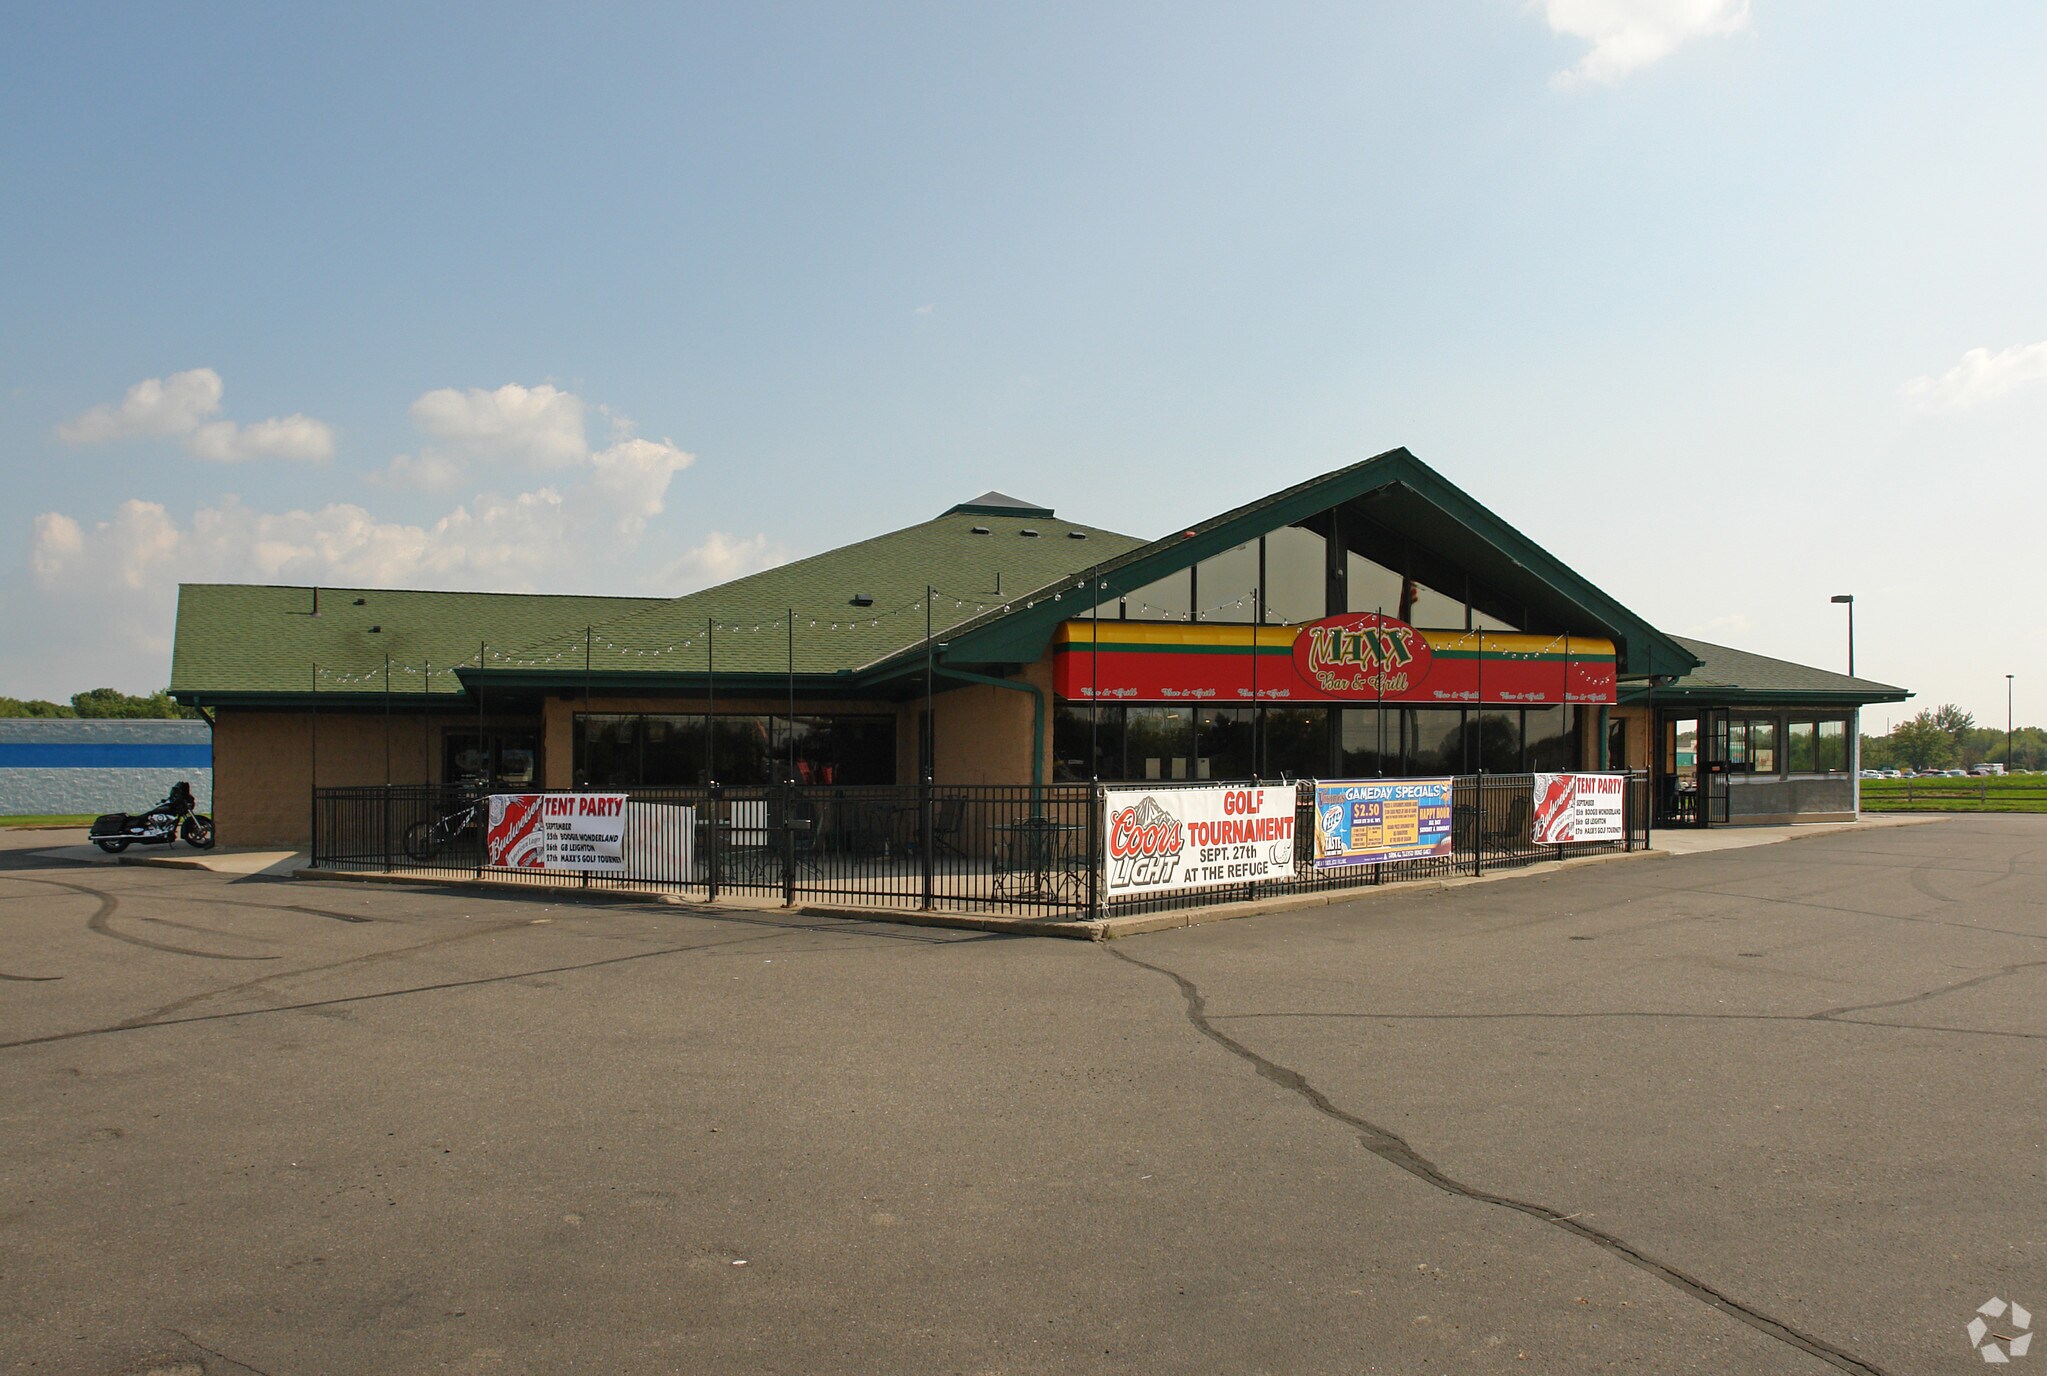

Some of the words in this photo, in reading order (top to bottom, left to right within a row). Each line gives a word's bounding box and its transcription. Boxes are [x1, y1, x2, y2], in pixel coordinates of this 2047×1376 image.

[1309, 626, 1413, 672] MAXX
[1316, 671, 1350, 690] Bar
[1351, 673, 1366, 690] &
[1368, 672, 1409, 697] Grill
[1345, 786, 1393, 801] GAMEDAY
[1395, 784, 1440, 799] SPECIALS
[1577, 777, 1595, 794] TENT
[1598, 778, 1622, 794] PARTY
[545, 797, 575, 816] TENT
[579, 797, 623, 817] PARTY
[1223, 790, 1264, 815] GOLF
[1354, 803, 1380, 818] $2.50
[1533, 775, 1576, 842] Budweiser
[1419, 808, 1436, 820] HAPPY
[1436, 807, 1450, 819] HOUR
[489, 795, 544, 866] Budweiser
[545, 823, 572, 831] SEPTEMBER
[1110, 806, 1185, 861] Coors
[1188, 816, 1294, 847] TOURNAMENT
[546, 833, 558, 841] 25th
[560, 833, 580, 841] BOOGIE
[579, 833, 619, 843] WONDERLAND
[546, 843, 558, 851] 26th
[560, 844, 569, 852] GB
[569, 843, 595, 852] LEIGHTON
[546, 854, 558, 862] 27th
[560, 854, 581, 863] MAXX'S
[581, 855, 597, 864] GOLF
[597, 855, 622, 864] TOURNEY
[1200, 846, 1229, 863] SEPT.
[1232, 845, 1257, 860] 27th
[1111, 854, 1180, 888] LIGHT
[1184, 867, 1198, 883] AT
[1202, 865, 1225, 881] THE
[1227, 861, 1269, 877] REFUGE
